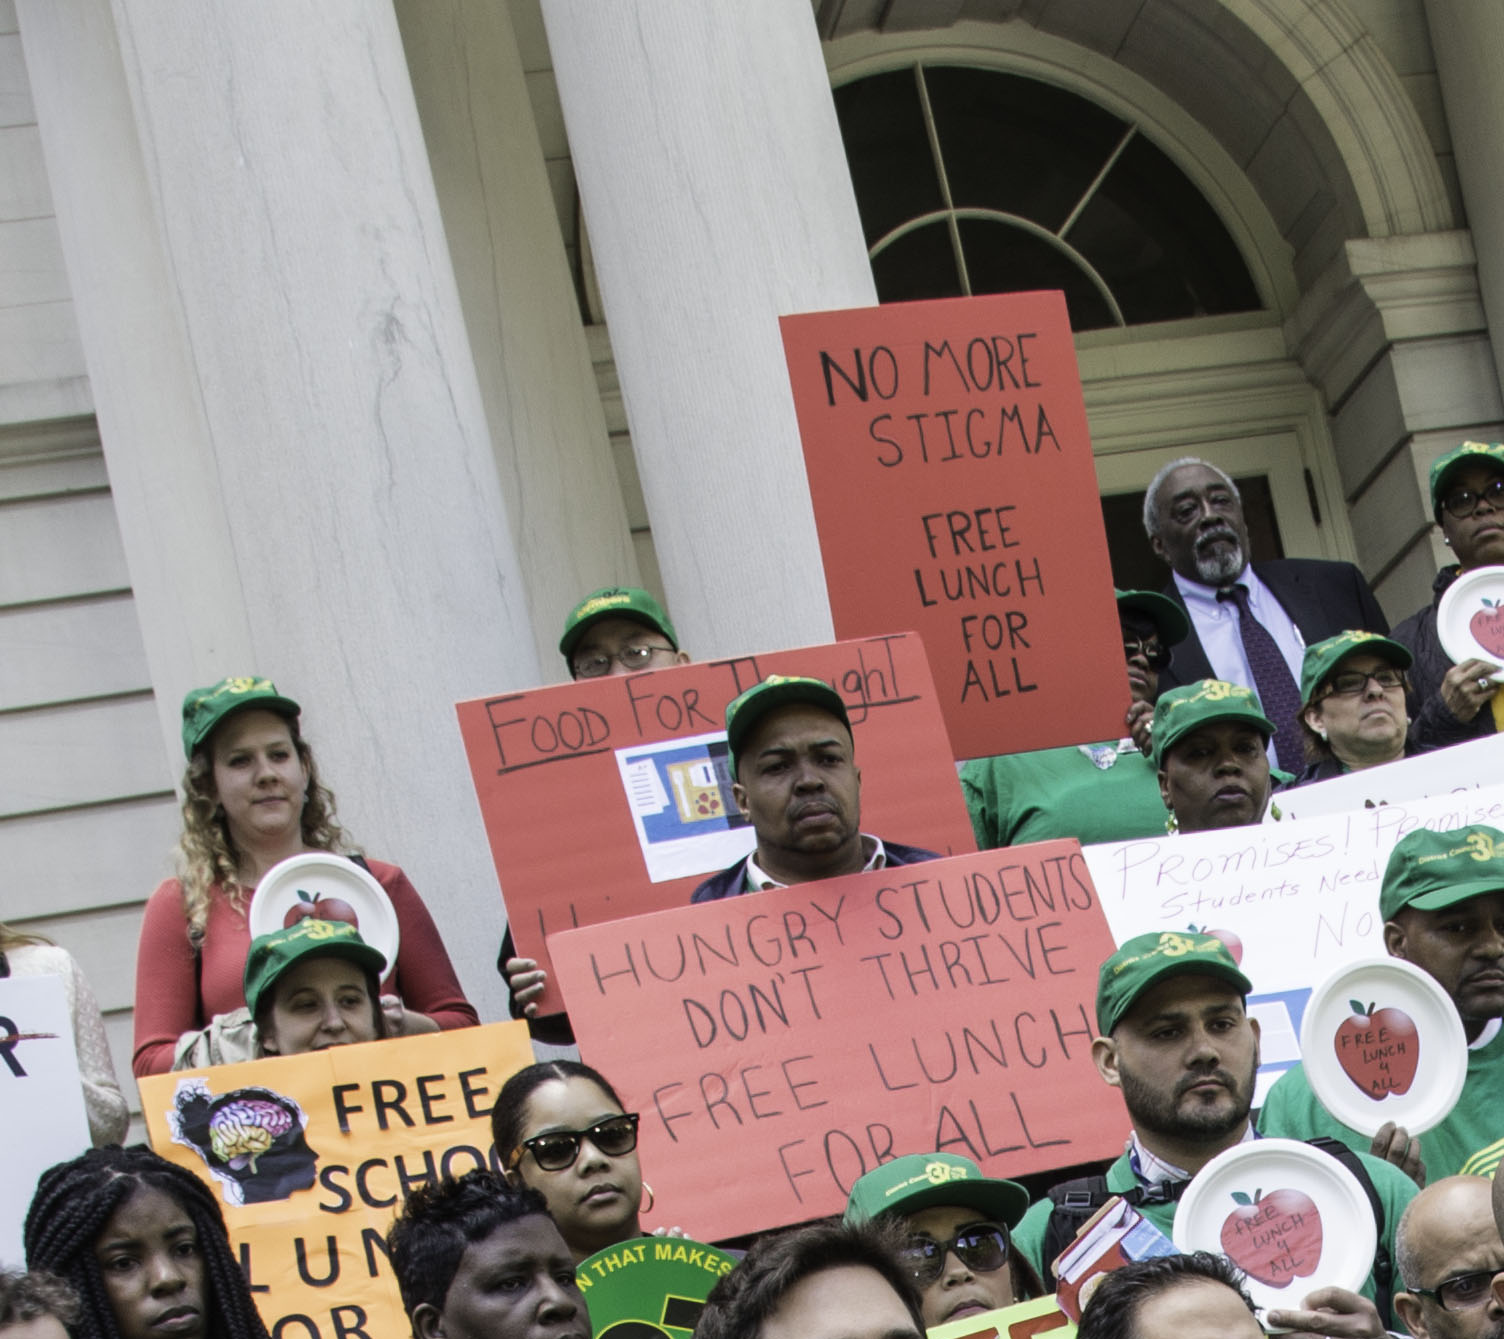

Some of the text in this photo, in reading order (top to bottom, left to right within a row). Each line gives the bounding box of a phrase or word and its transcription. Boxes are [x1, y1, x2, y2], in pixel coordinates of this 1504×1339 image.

[818, 332, 1043, 407] NO MORE
[870, 404, 1062, 469] STIGMA
[921, 503, 1022, 561] FREE
[914, 556, 1047, 608] LUNCH
[960, 611, 1032, 655] FOR
[960, 657, 1039, 705] ALL
[485, 694, 612, 767] FOOD
[625, 671, 719, 736] FOR
[1160, 858, 1380, 919] Students Need
[589, 899, 849, 999] HUNGRY
[876, 850, 1094, 940] STUDENTS
[683, 921, 1077, 1050] DON'T THRIVE
[1341, 1026, 1391, 1049] FREE
[1362, 1041, 1407, 1064] LUNCH
[652, 1000, 1095, 1143] FREE LUNCH
[1371, 1077, 1401, 1092] ALL
[331, 1066, 494, 1134] FREE
[779, 1089, 1072, 1205] FOR ALL
[1234, 1205, 1281, 1236] FREE
[1253, 1212, 1305, 1249] LUNCH
[592, 1244, 733, 1278] THAT MAKES
[1269, 1255, 1305, 1277] ALL
